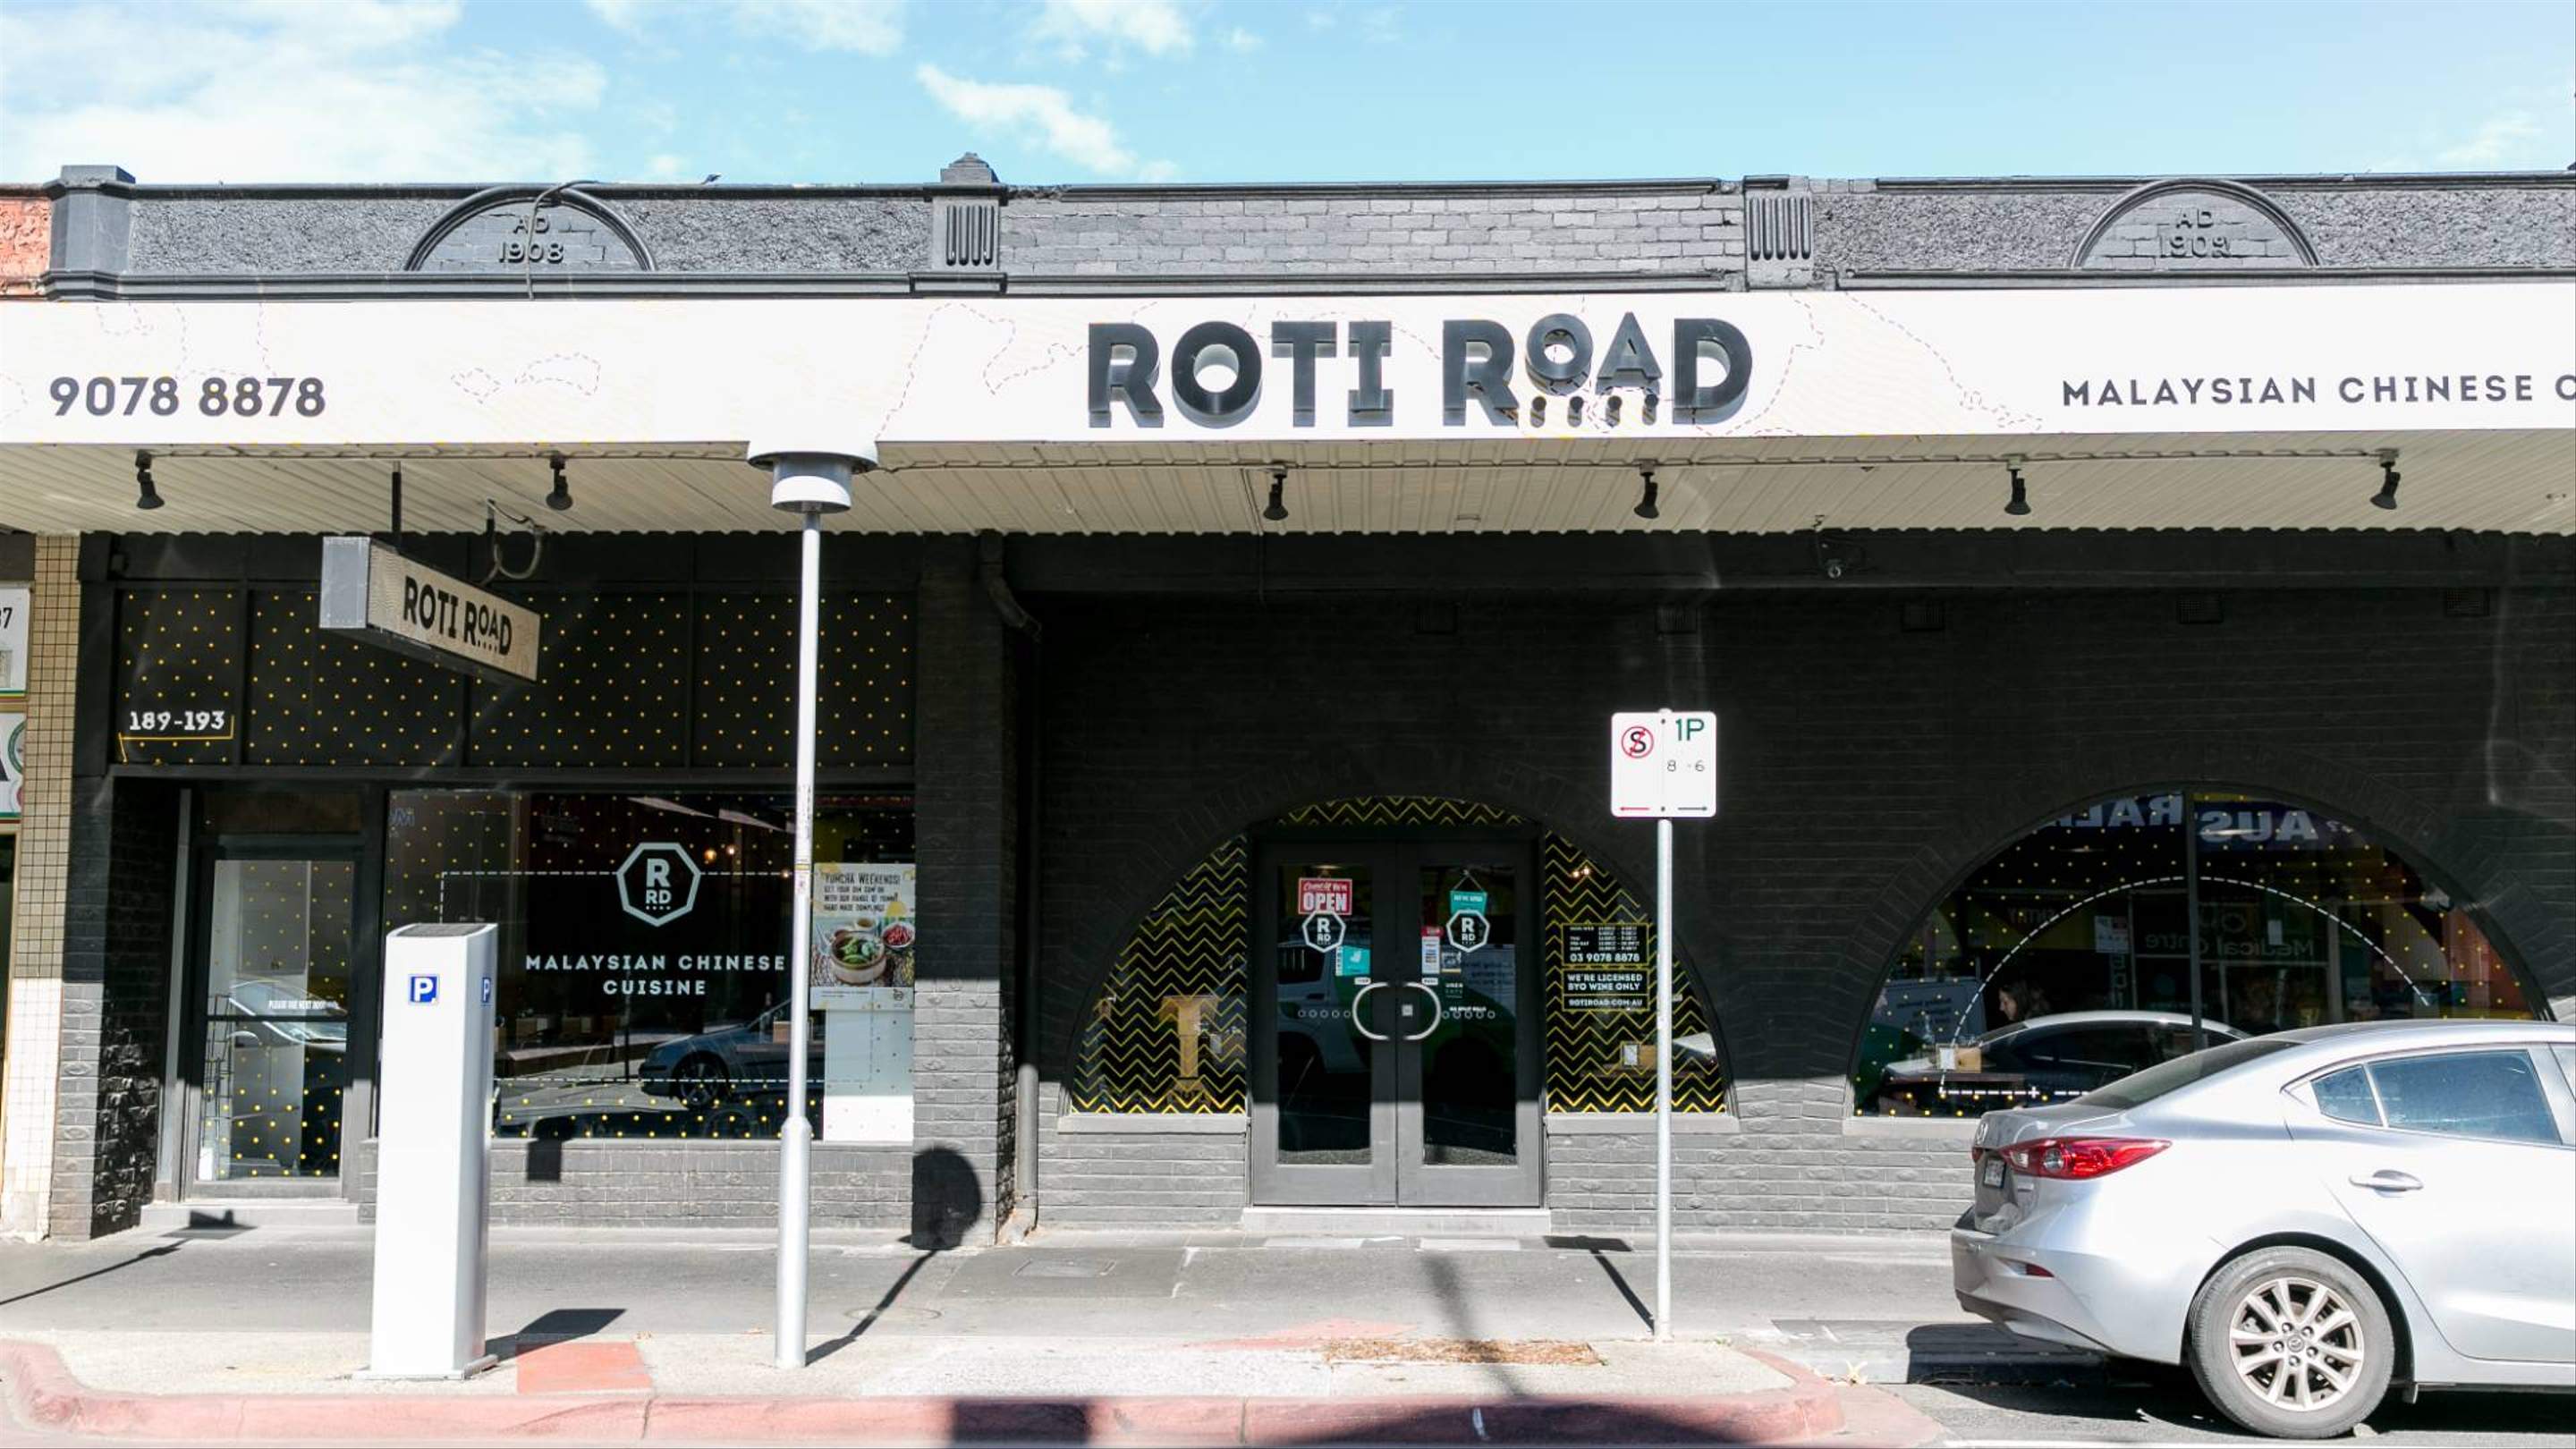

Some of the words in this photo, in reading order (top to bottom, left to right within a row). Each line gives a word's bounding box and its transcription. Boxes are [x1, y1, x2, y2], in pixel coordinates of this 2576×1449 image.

[513, 215, 550, 233] AD
[2175, 207, 2214, 228] AD
[498, 242, 564, 264] 1908
[1089, 320, 1393, 428] ROTI
[1443, 311, 1753, 428] ROAD
[49, 377, 180, 418] 9078
[199, 377, 326, 418] 8878
[2063, 376, 2317, 407] MALAYSIAN
[2338, 374, 2534, 403] CHINESE
[403, 575, 459, 639] ROTI
[463, 600, 513, 656] ROAD
[129, 710, 225, 731] 189-193
[1675, 718, 1705, 741] 1P
[646, 858, 671, 887] R
[646, 889, 672, 904] RD
[1302, 892, 1348, 912] OPEN
[1317, 918, 1331, 933] R
[1461, 917, 1475, 933] R
[1317, 933, 1332, 942] RD
[1461, 933, 1476, 942] RD
[525, 954, 666, 970] MALAYSIAN
[678, 954, 785, 971] CHINESE
[1570, 953, 1583, 962] 03
[1586, 953, 1612, 962] 9078
[1614, 953, 1640, 962] 8878
[1567, 973, 1596, 982] WE'RE
[1597, 973, 1643, 982] LICENSED
[1567, 983, 1587, 991] BYO
[1589, 983, 1614, 991] WINE
[1615, 983, 1640, 991] ONLY
[413, 977, 434, 1002] P
[603, 979, 707, 996] CUISINE
